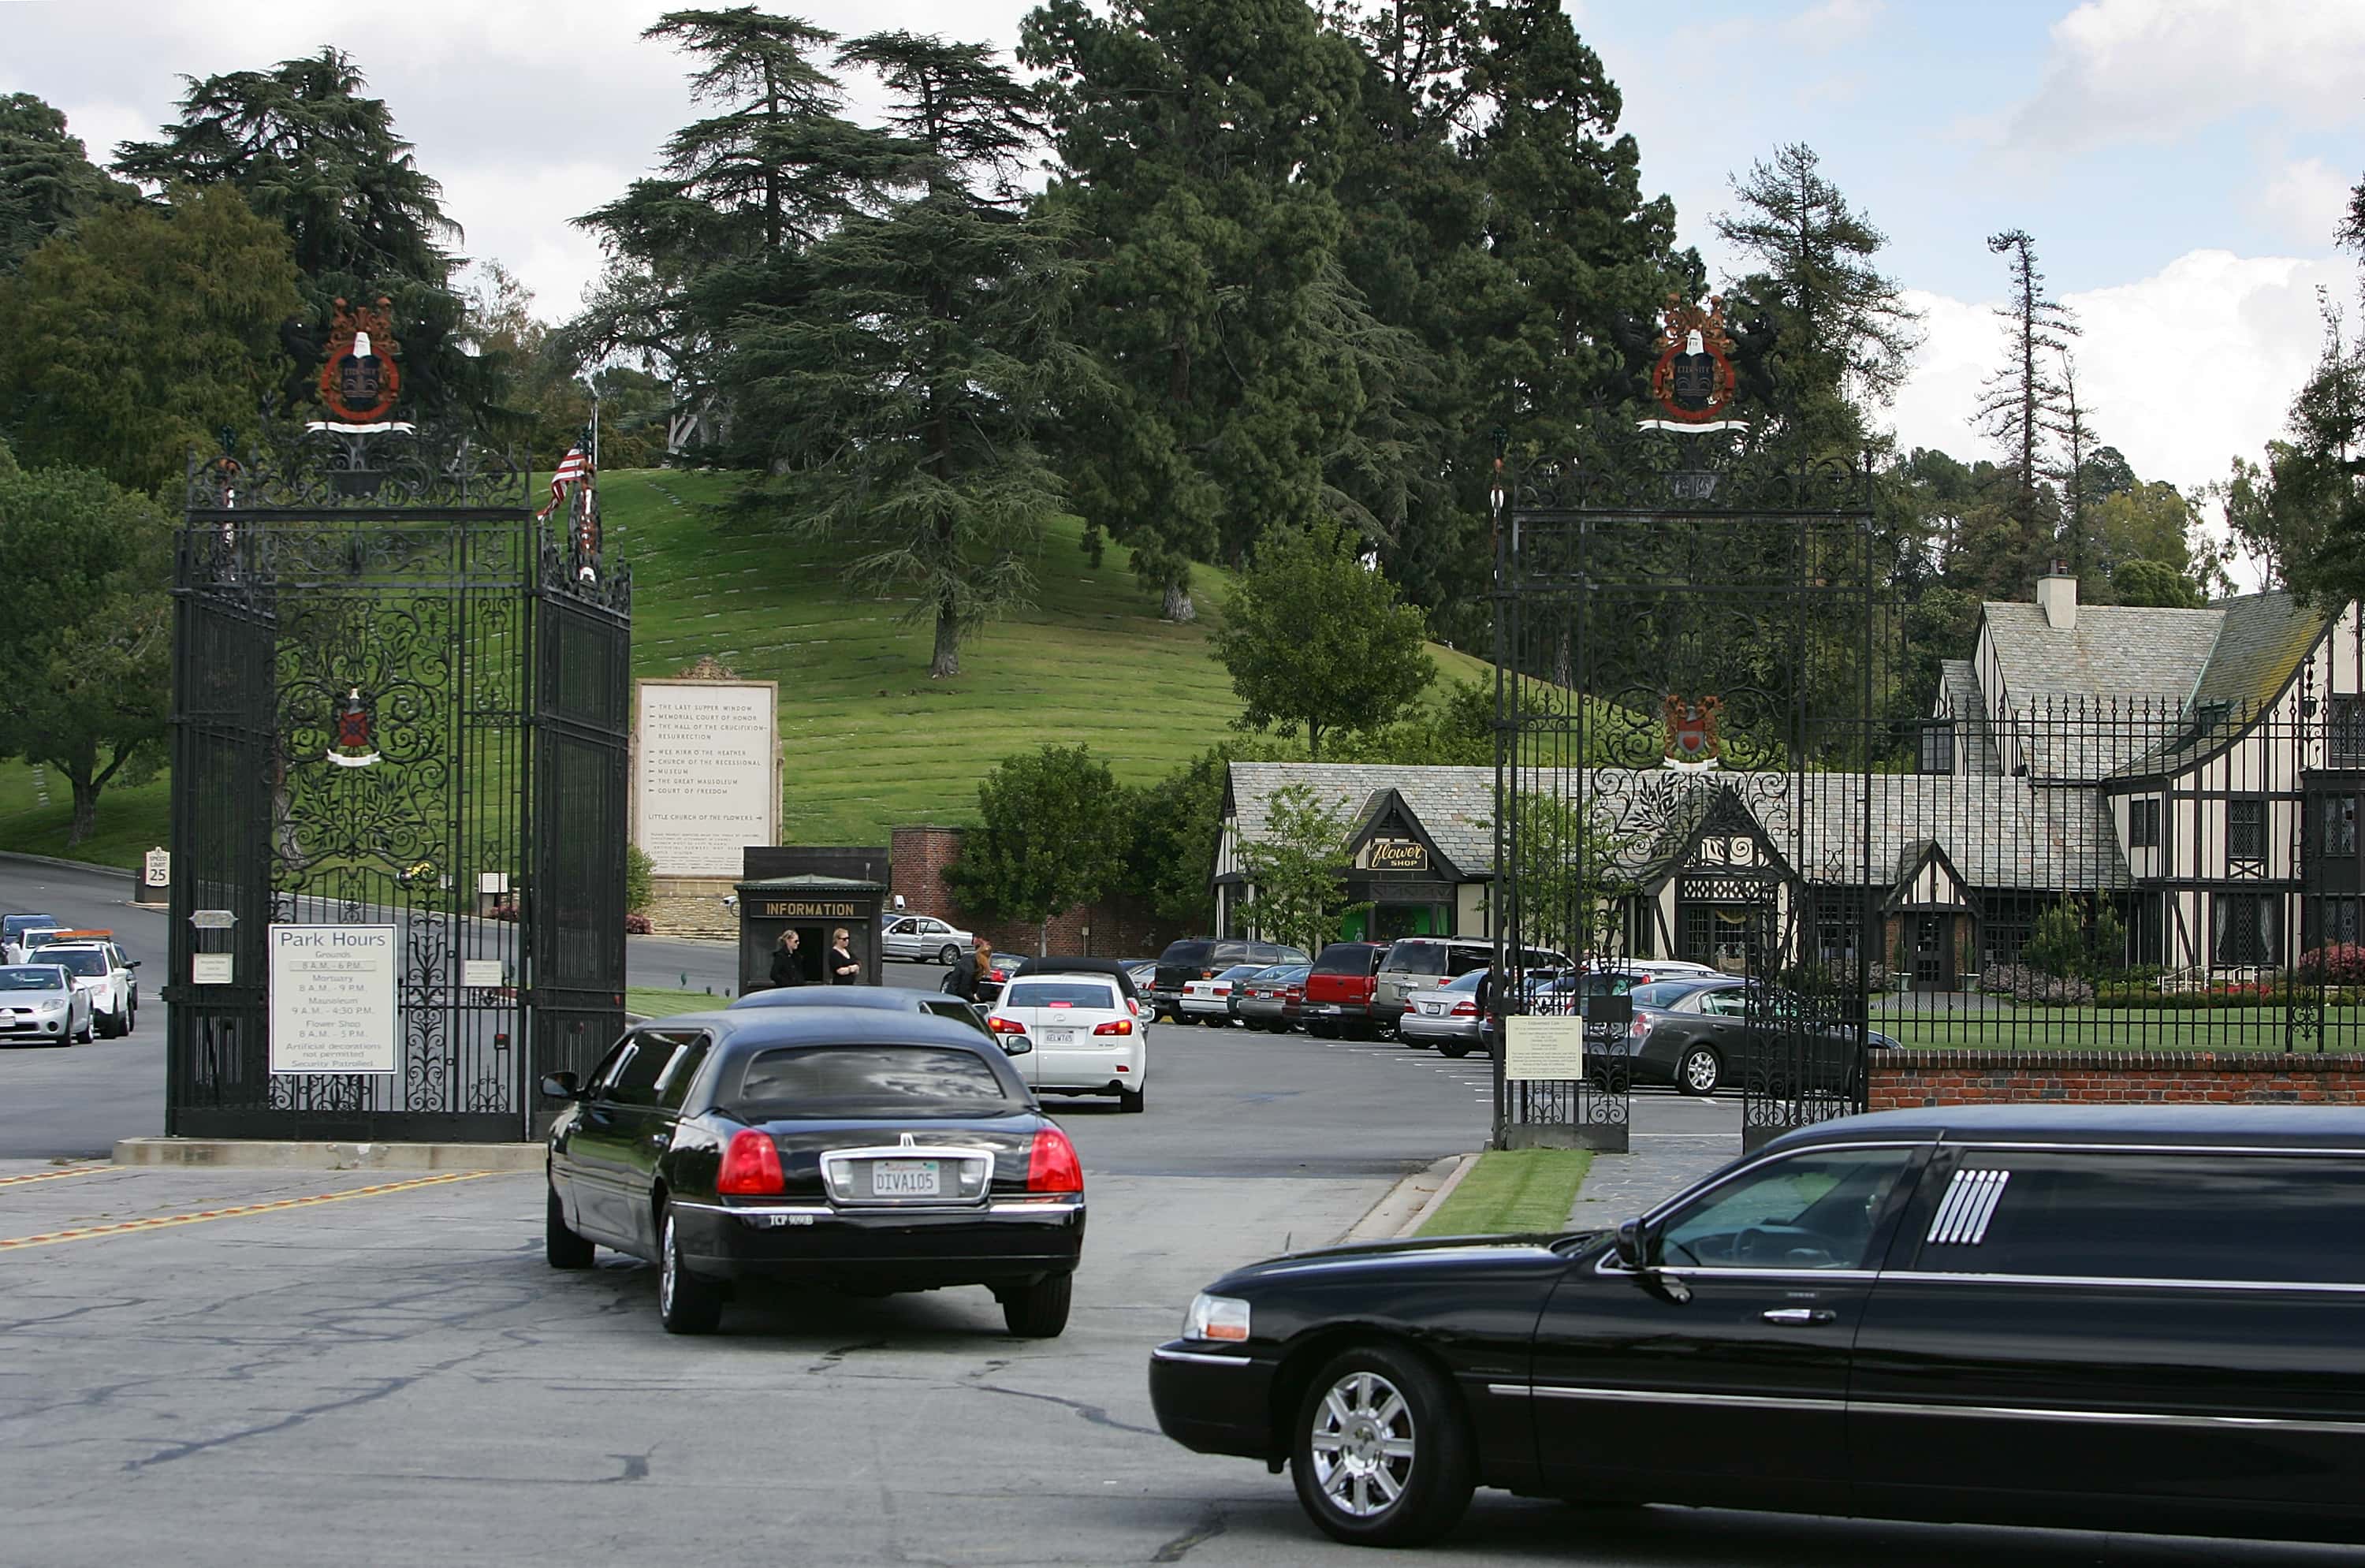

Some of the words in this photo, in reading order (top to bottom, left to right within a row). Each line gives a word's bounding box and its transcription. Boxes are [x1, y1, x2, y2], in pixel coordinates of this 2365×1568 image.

[1372, 843, 1422, 867] flower
[150, 869, 166, 881] 25
[766, 903, 855, 916] INFORMATION
[281, 932, 323, 946] Park
[333, 933, 385, 946] Hours
[877, 1173, 934, 1191] DIVA105
[769, 1215, 788, 1226] TCP
